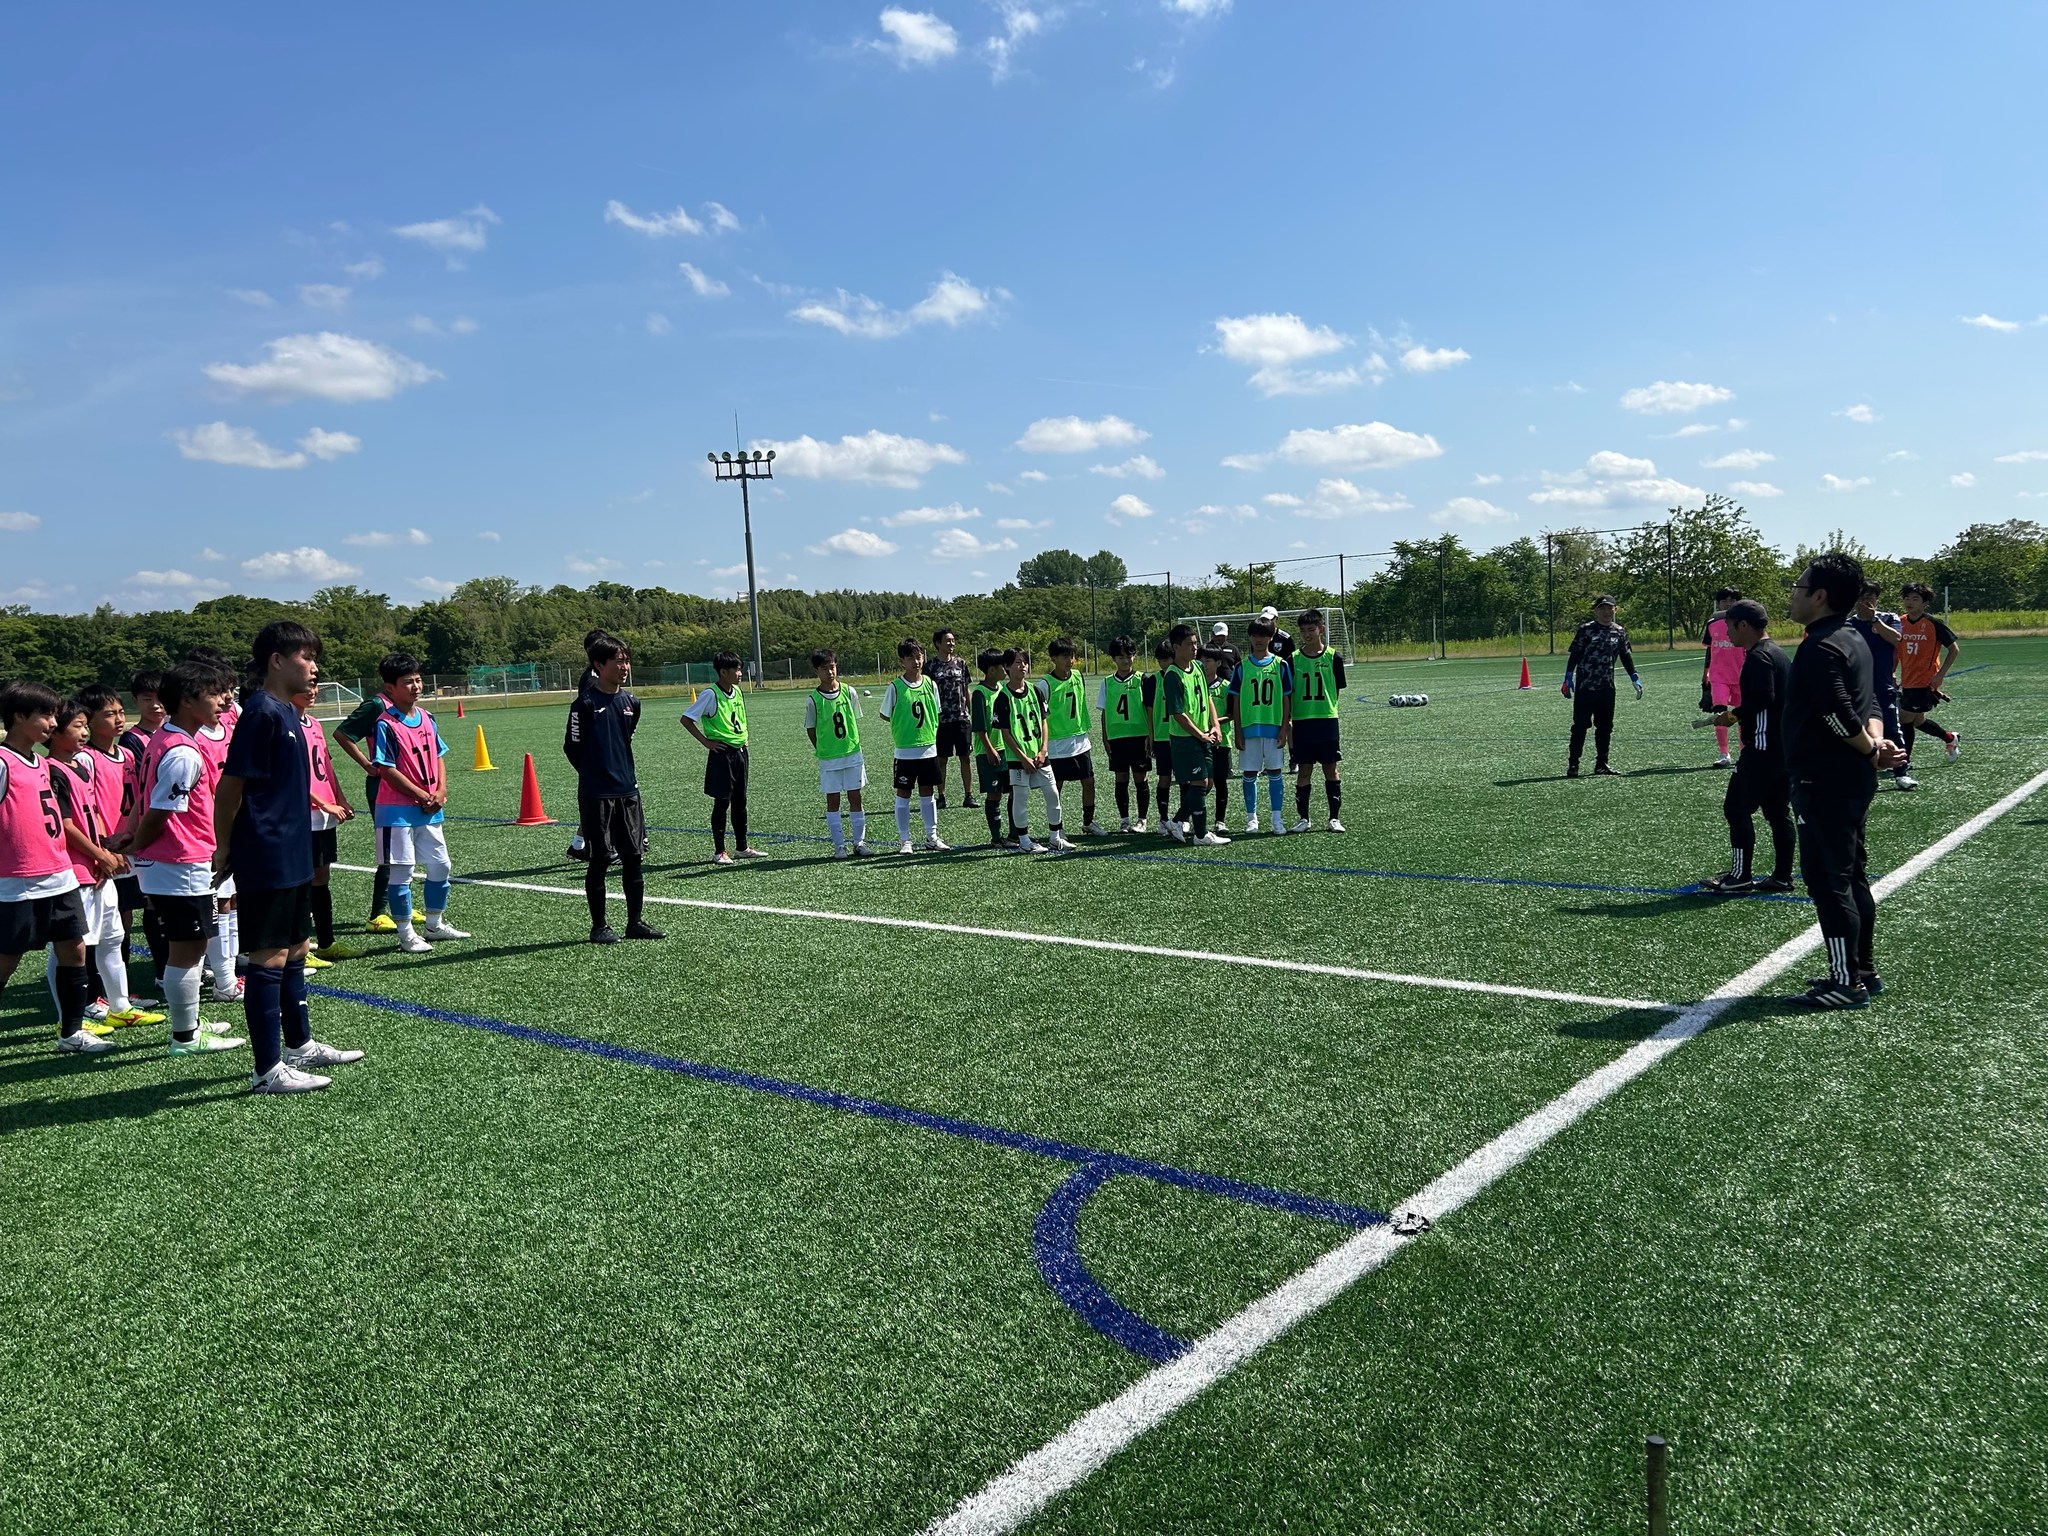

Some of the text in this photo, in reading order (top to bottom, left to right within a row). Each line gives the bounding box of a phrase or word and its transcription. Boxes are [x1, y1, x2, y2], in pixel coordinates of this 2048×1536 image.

[1906, 642, 1919, 655] 51
[1250, 678, 1274, 706] 10
[1302, 672, 1326, 701] 11
[911, 700, 925, 729] 9
[1065, 692, 1077, 719] 7
[1116, 694, 1129, 721] 4
[571, 711, 581, 743] FINTA
[833, 711, 847, 739] 8
[1016, 710, 1041, 742] 13
[412, 744, 436, 785] 11
[39, 790, 62, 839] 5
